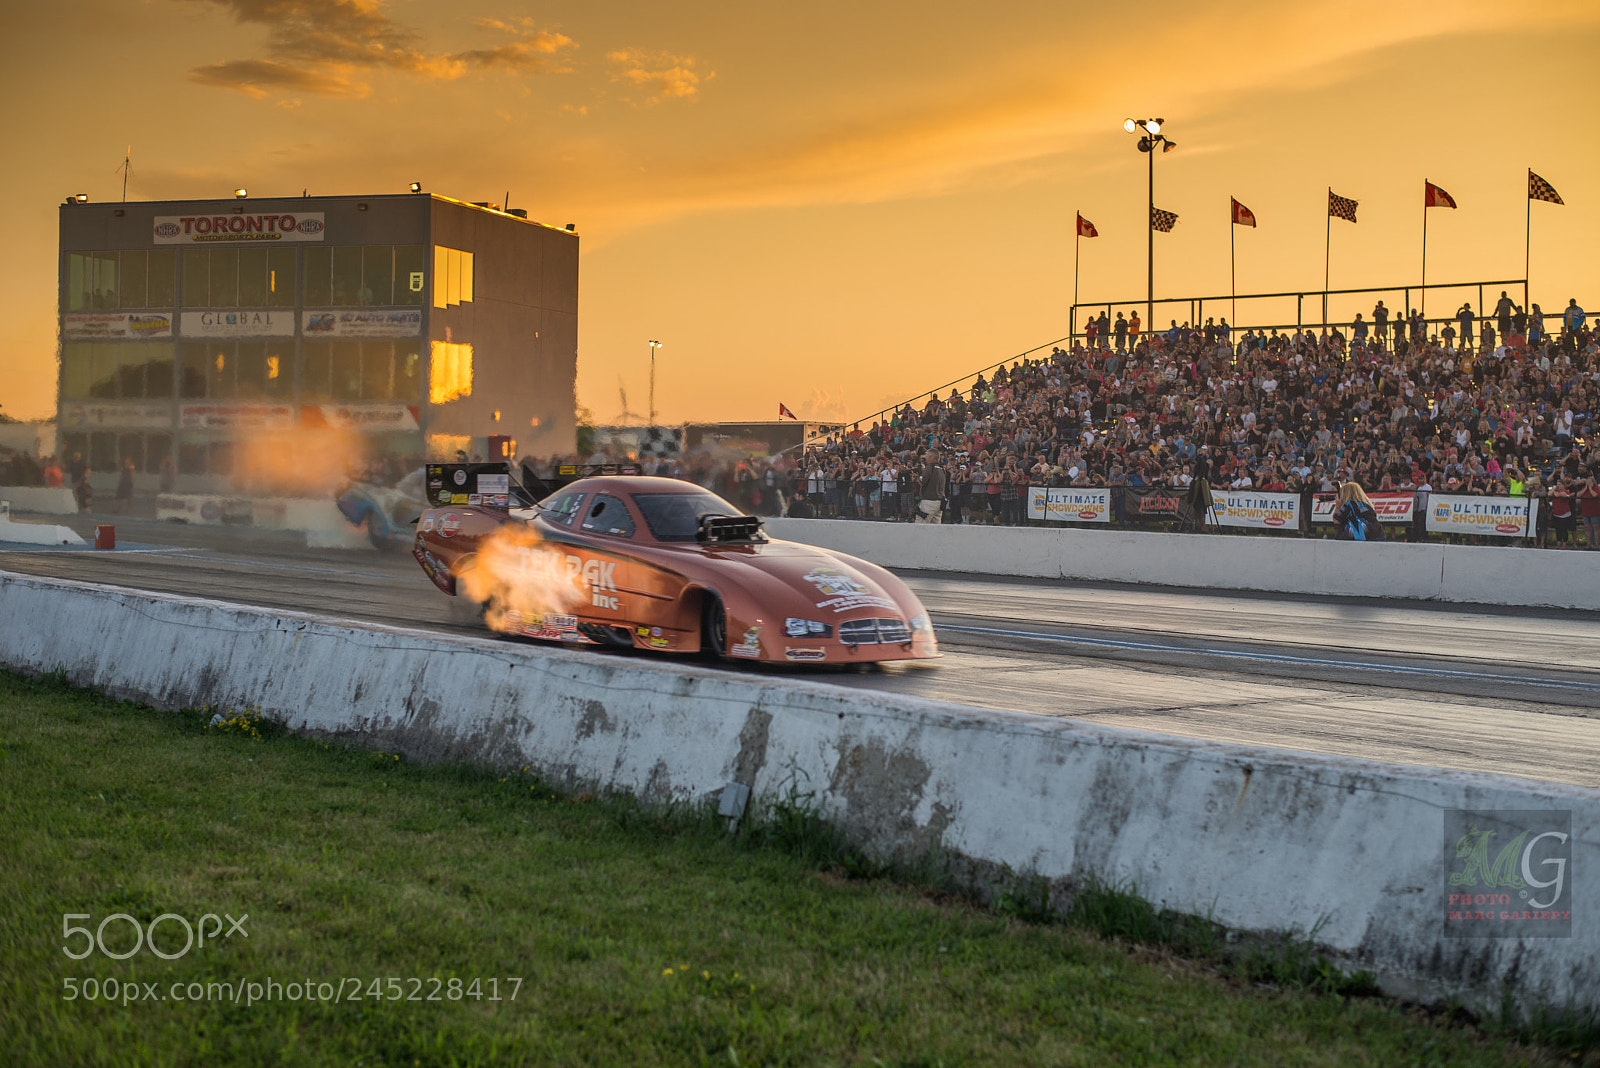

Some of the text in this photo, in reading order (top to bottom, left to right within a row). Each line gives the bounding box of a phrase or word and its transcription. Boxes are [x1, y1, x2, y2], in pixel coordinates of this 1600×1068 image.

[155, 223, 180, 236] NHRA
[180, 215, 296, 234] TORONTO
[298, 219, 323, 233] NHRA
[1048, 495, 1105, 504] ULTIMATE
[1139, 495, 1180, 514] ATCHISON
[1228, 498, 1295, 510] ULTIMATE
[1047, 503, 1105, 513] SHOWDOWNS
[1228, 508, 1294, 520] SHOWDOWNS
[1435, 508, 1450, 517] NAPA
[1453, 503, 1529, 516] ULTIMATE
[1452, 513, 1528, 527] SHOWDOWNS
[565, 554, 618, 593] PAK
